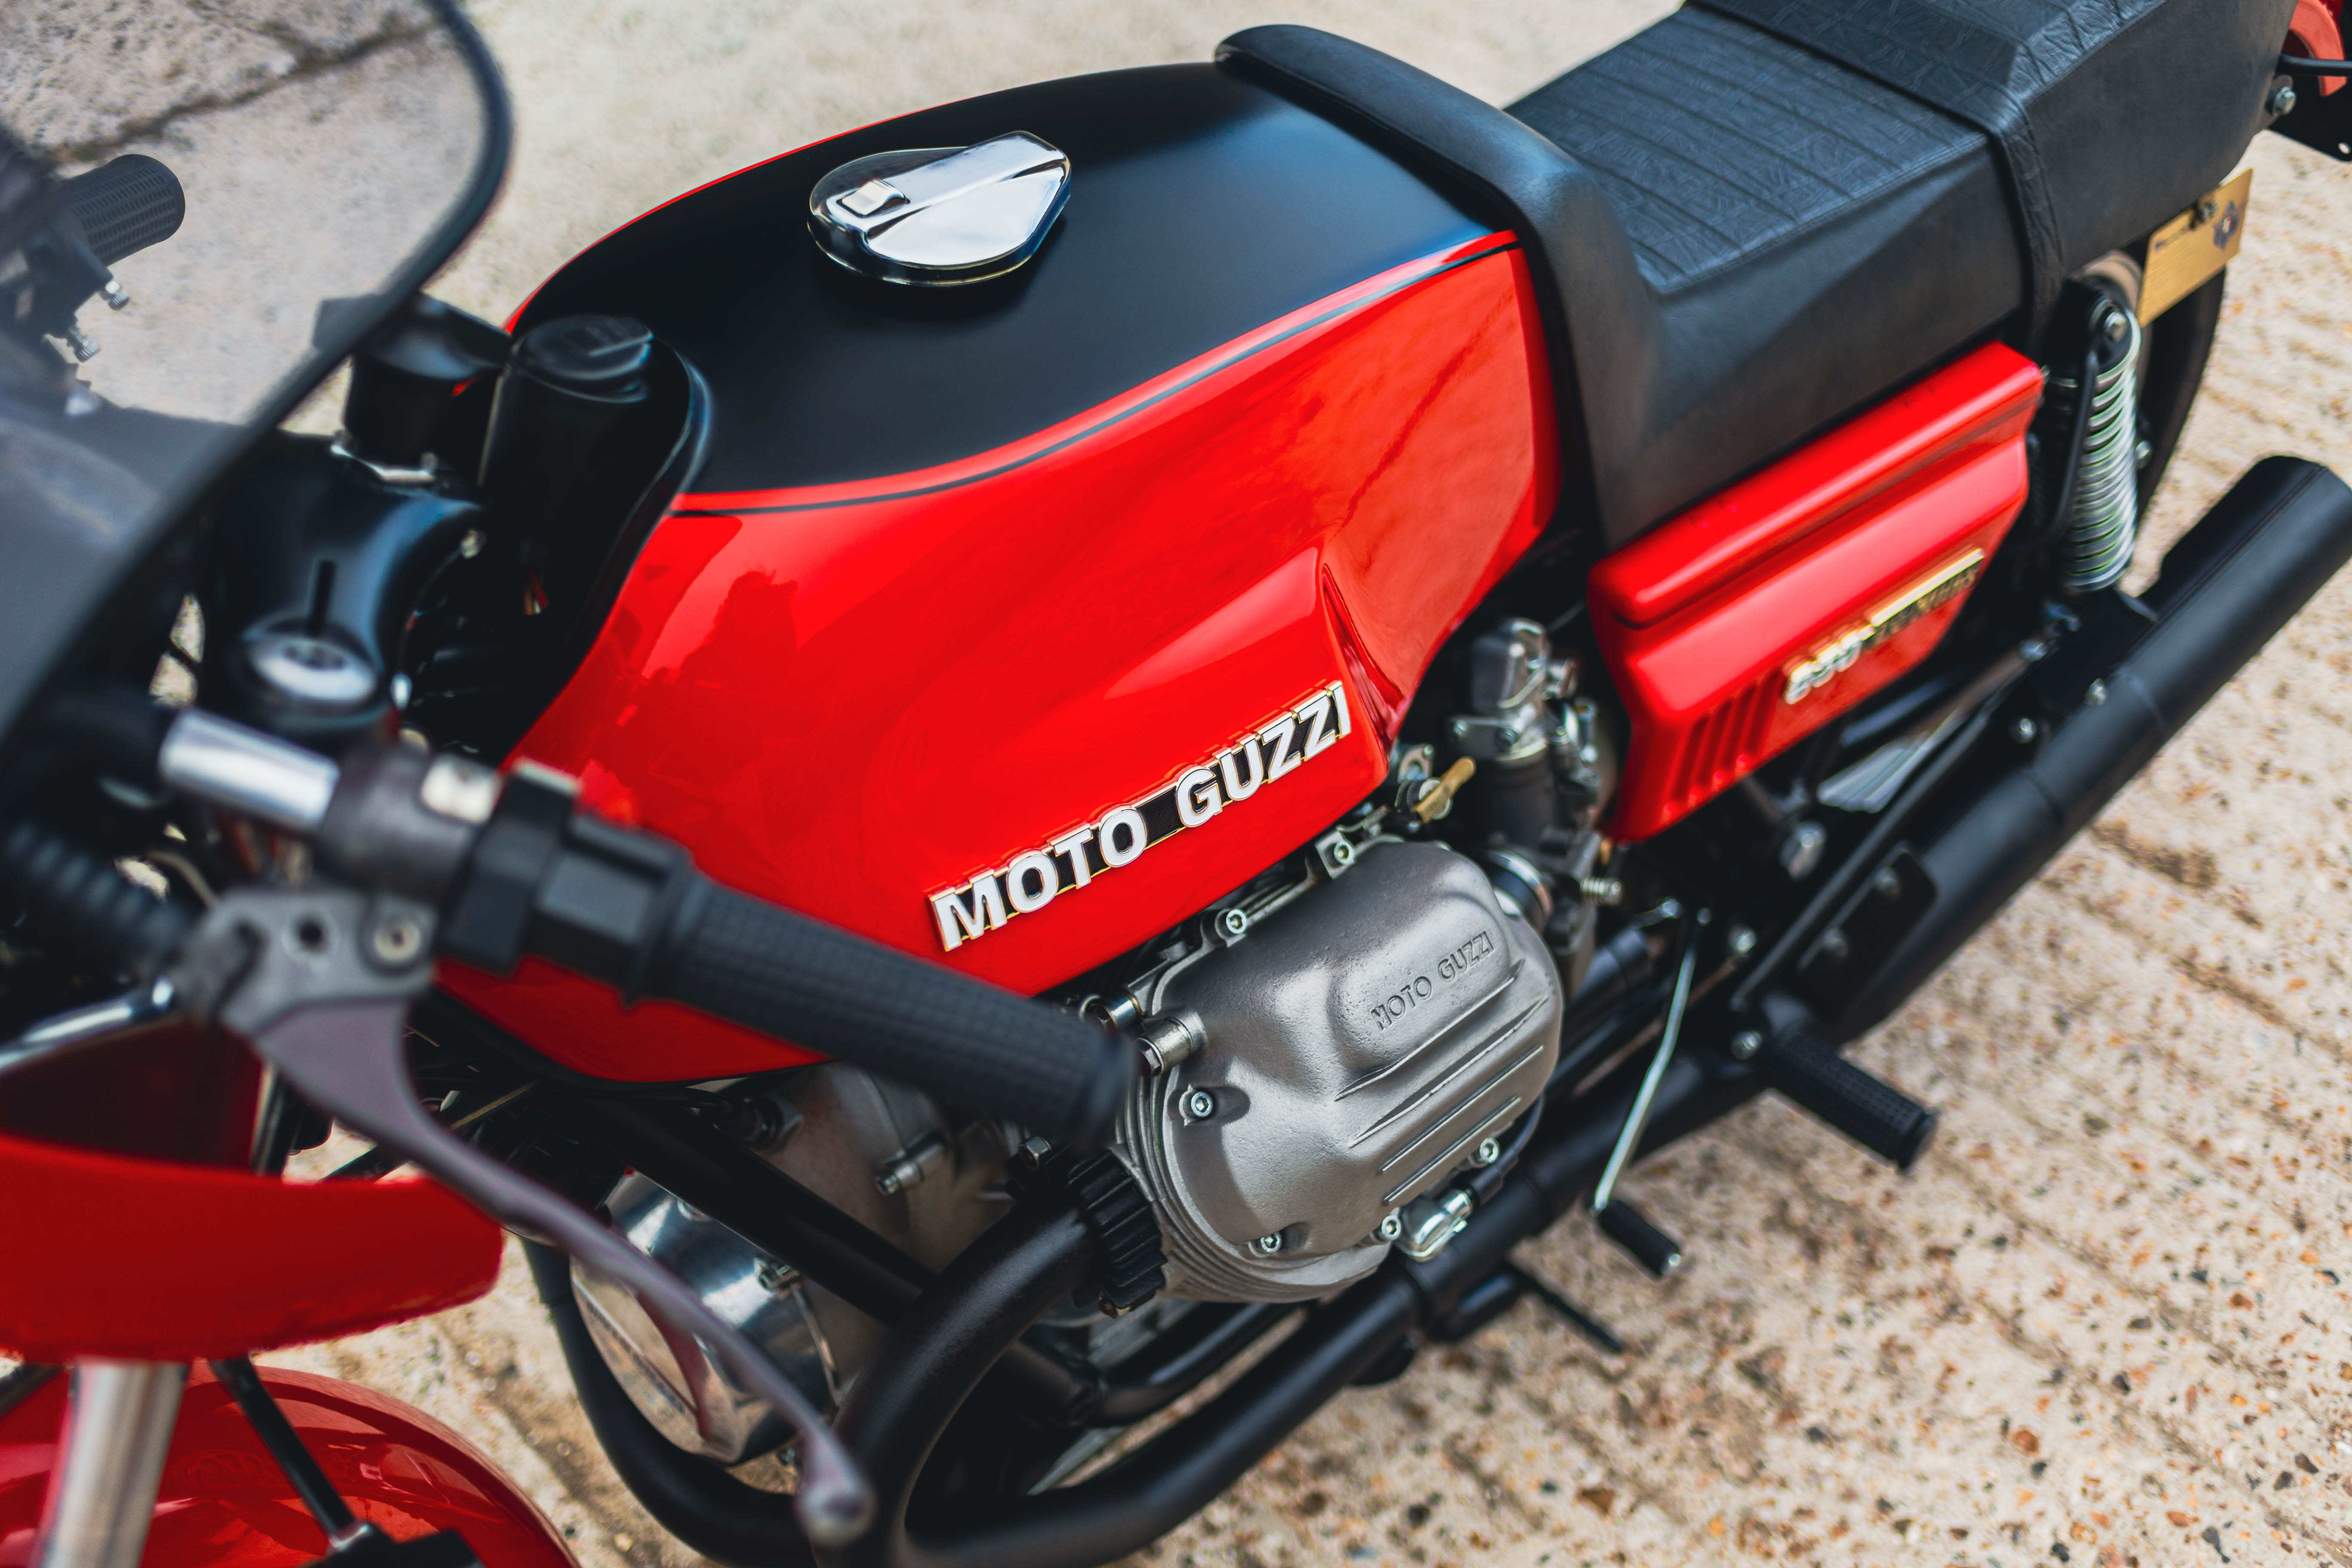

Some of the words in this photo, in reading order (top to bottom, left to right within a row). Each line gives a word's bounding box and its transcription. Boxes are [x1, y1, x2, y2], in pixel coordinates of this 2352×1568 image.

[930, 804, 1147, 952] MOTO
[1174, 680, 1352, 828] GUZZI
[1371, 976, 1432, 1031] MOTO
[1438, 931, 1494, 983] GUZZI
